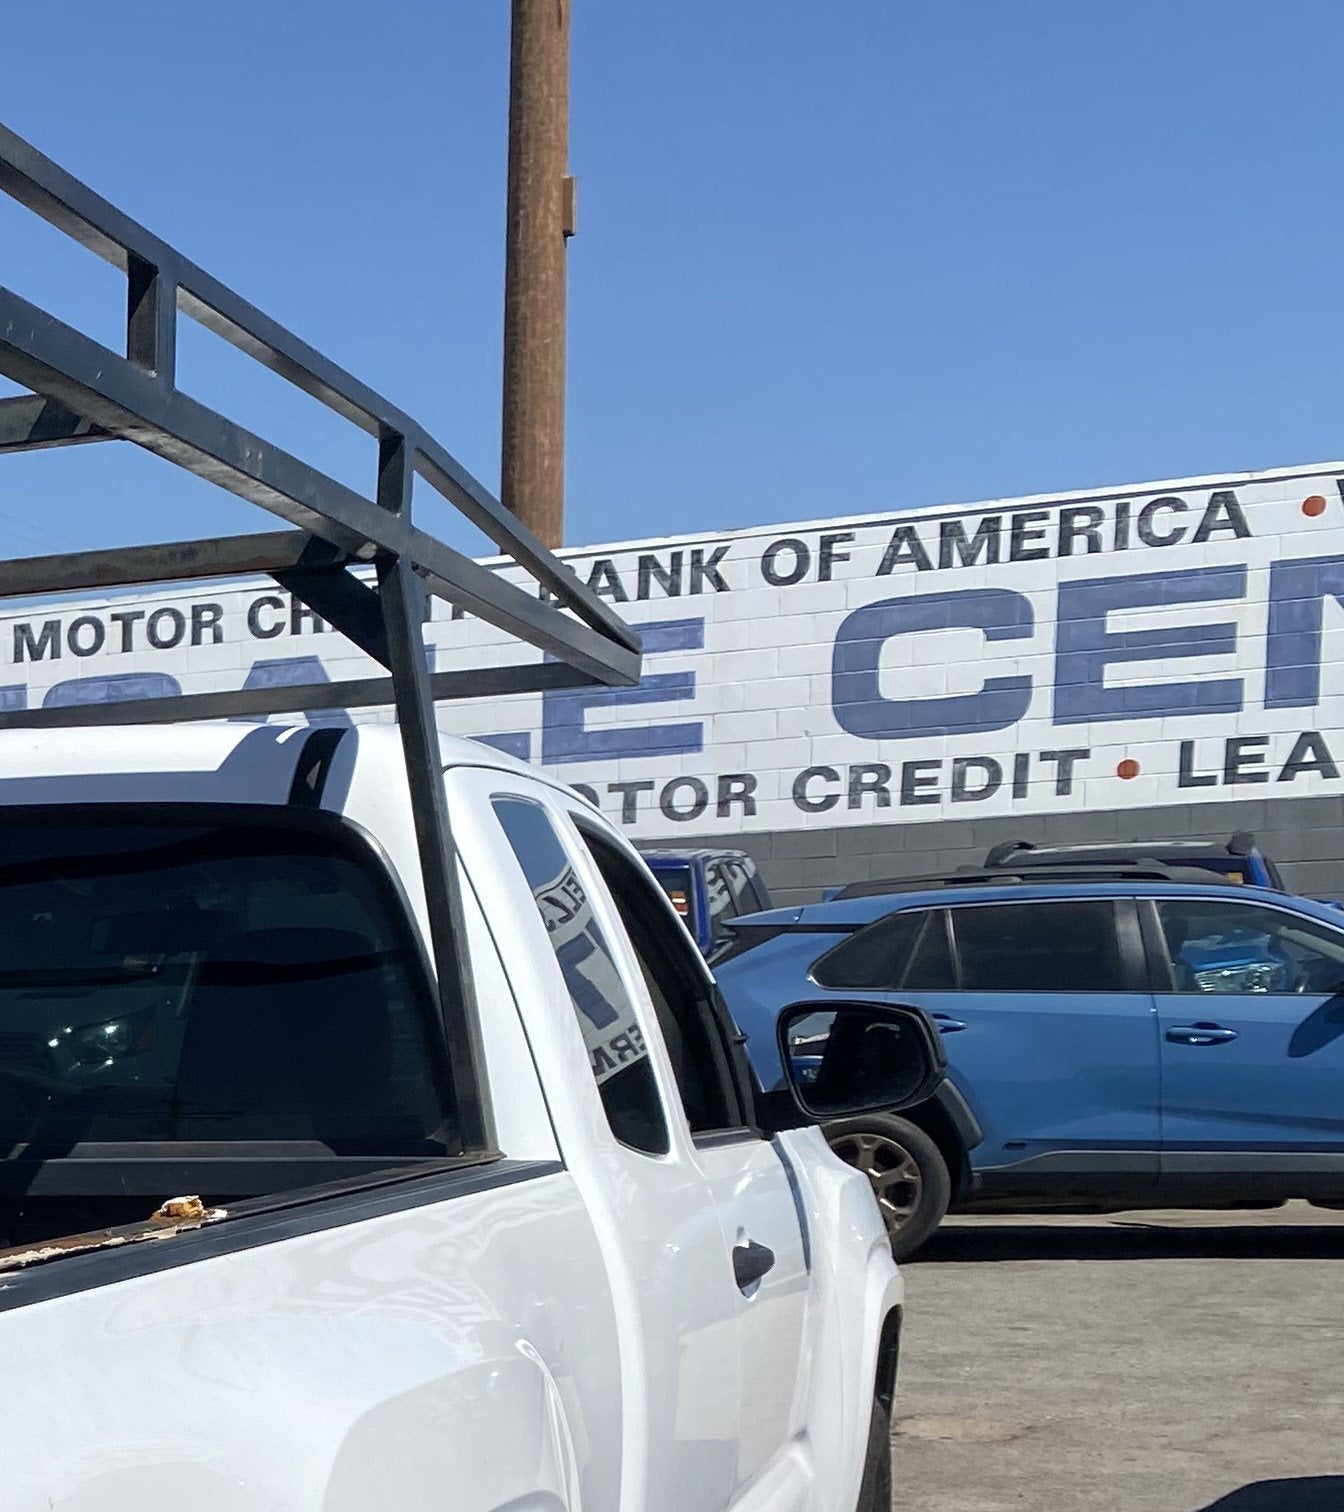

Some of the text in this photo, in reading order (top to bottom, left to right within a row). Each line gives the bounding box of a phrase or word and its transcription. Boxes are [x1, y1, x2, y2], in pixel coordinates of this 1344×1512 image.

[13, 603, 222, 664] MOTOR
[761, 532, 856, 586] OF
[875, 490, 1252, 576] AMERICA
[792, 749, 1091, 813] CREDIT
